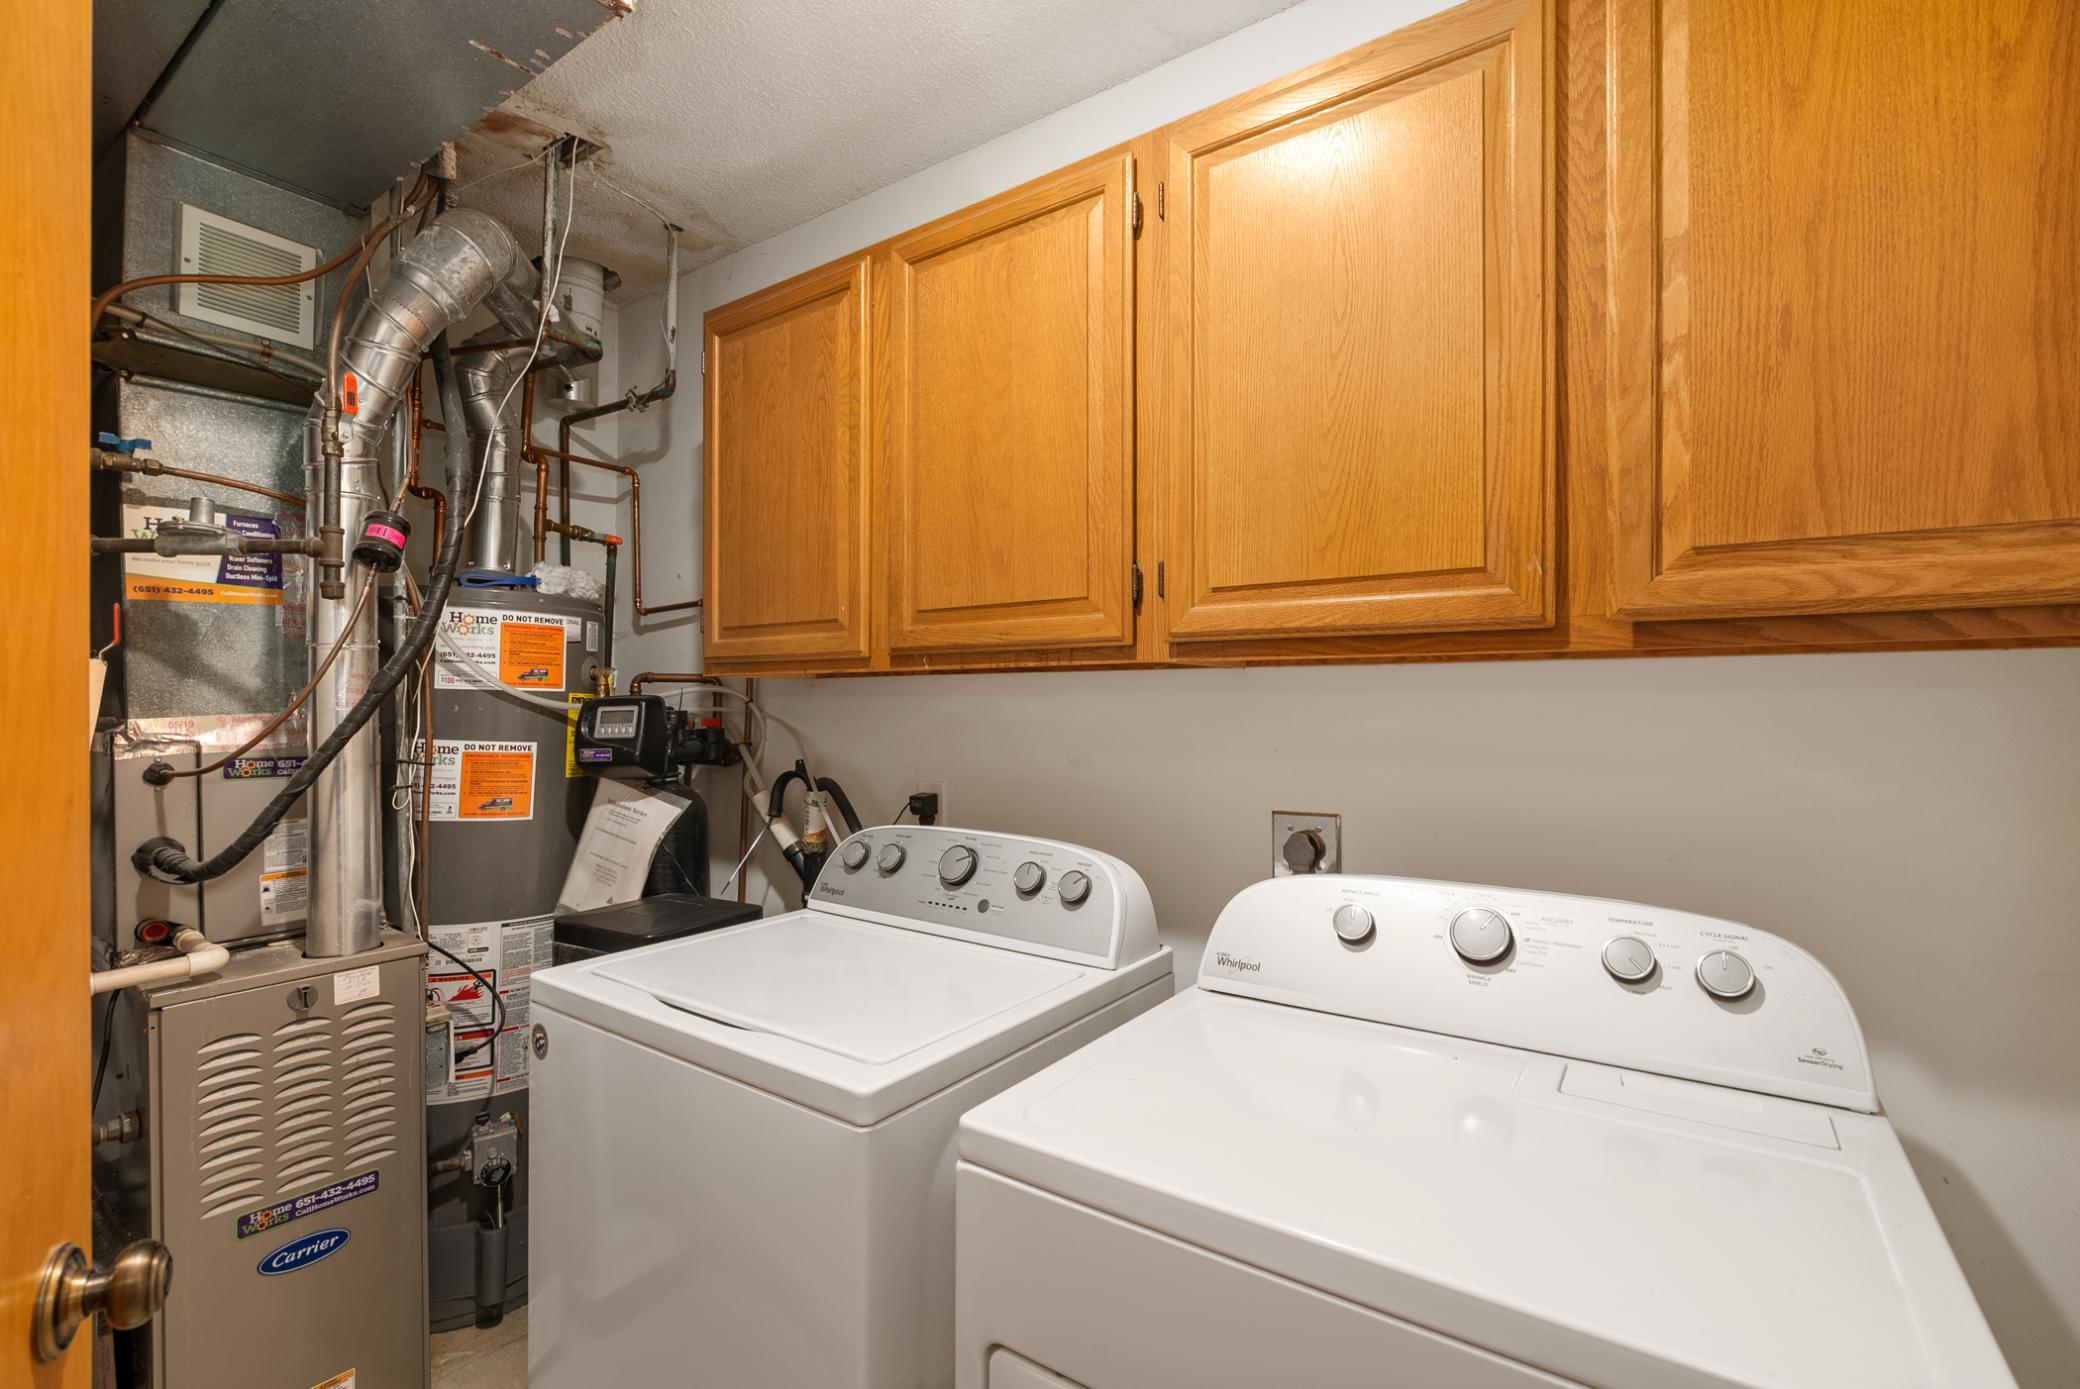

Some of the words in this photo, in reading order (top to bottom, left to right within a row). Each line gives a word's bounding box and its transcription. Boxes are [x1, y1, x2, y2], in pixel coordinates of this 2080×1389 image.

[233, 520, 259, 529] Furnaces
[242, 530, 275, 539] Conditioning
[243, 565, 267, 574] Cleaning
[133, 585, 161, 594] (651)
[163, 587, 214, 596] 432-4495
[450, 611, 498, 625] Home
[502, 614, 514, 622] DO
[516, 615, 532, 623] NOT
[534, 617, 564, 626] REMOVE
[441, 622, 494, 636] Works
[464, 743, 476, 751] DO
[499, 744, 533, 752] REMOVE
[234, 759, 274, 769] Home
[227, 766, 272, 777] Works
[820, 885, 846, 897] Whirlpool
[1608, 917, 1653, 927] TEMPERATURE
[1700, 930, 1721, 939] CYCLE
[1723, 933, 1749, 942] SIGNAL
[1216, 955, 1261, 972] Whirlpool
[1798, 1056, 1844, 1071] SensorDrying
[295, 1173, 376, 1209] 651-432-4495
[295, 1184, 376, 1217] CallHomeWorks.com
[249, 1203, 293, 1224] Home
[241, 1212, 290, 1234] Works
[272, 1235, 340, 1268] Carrier
